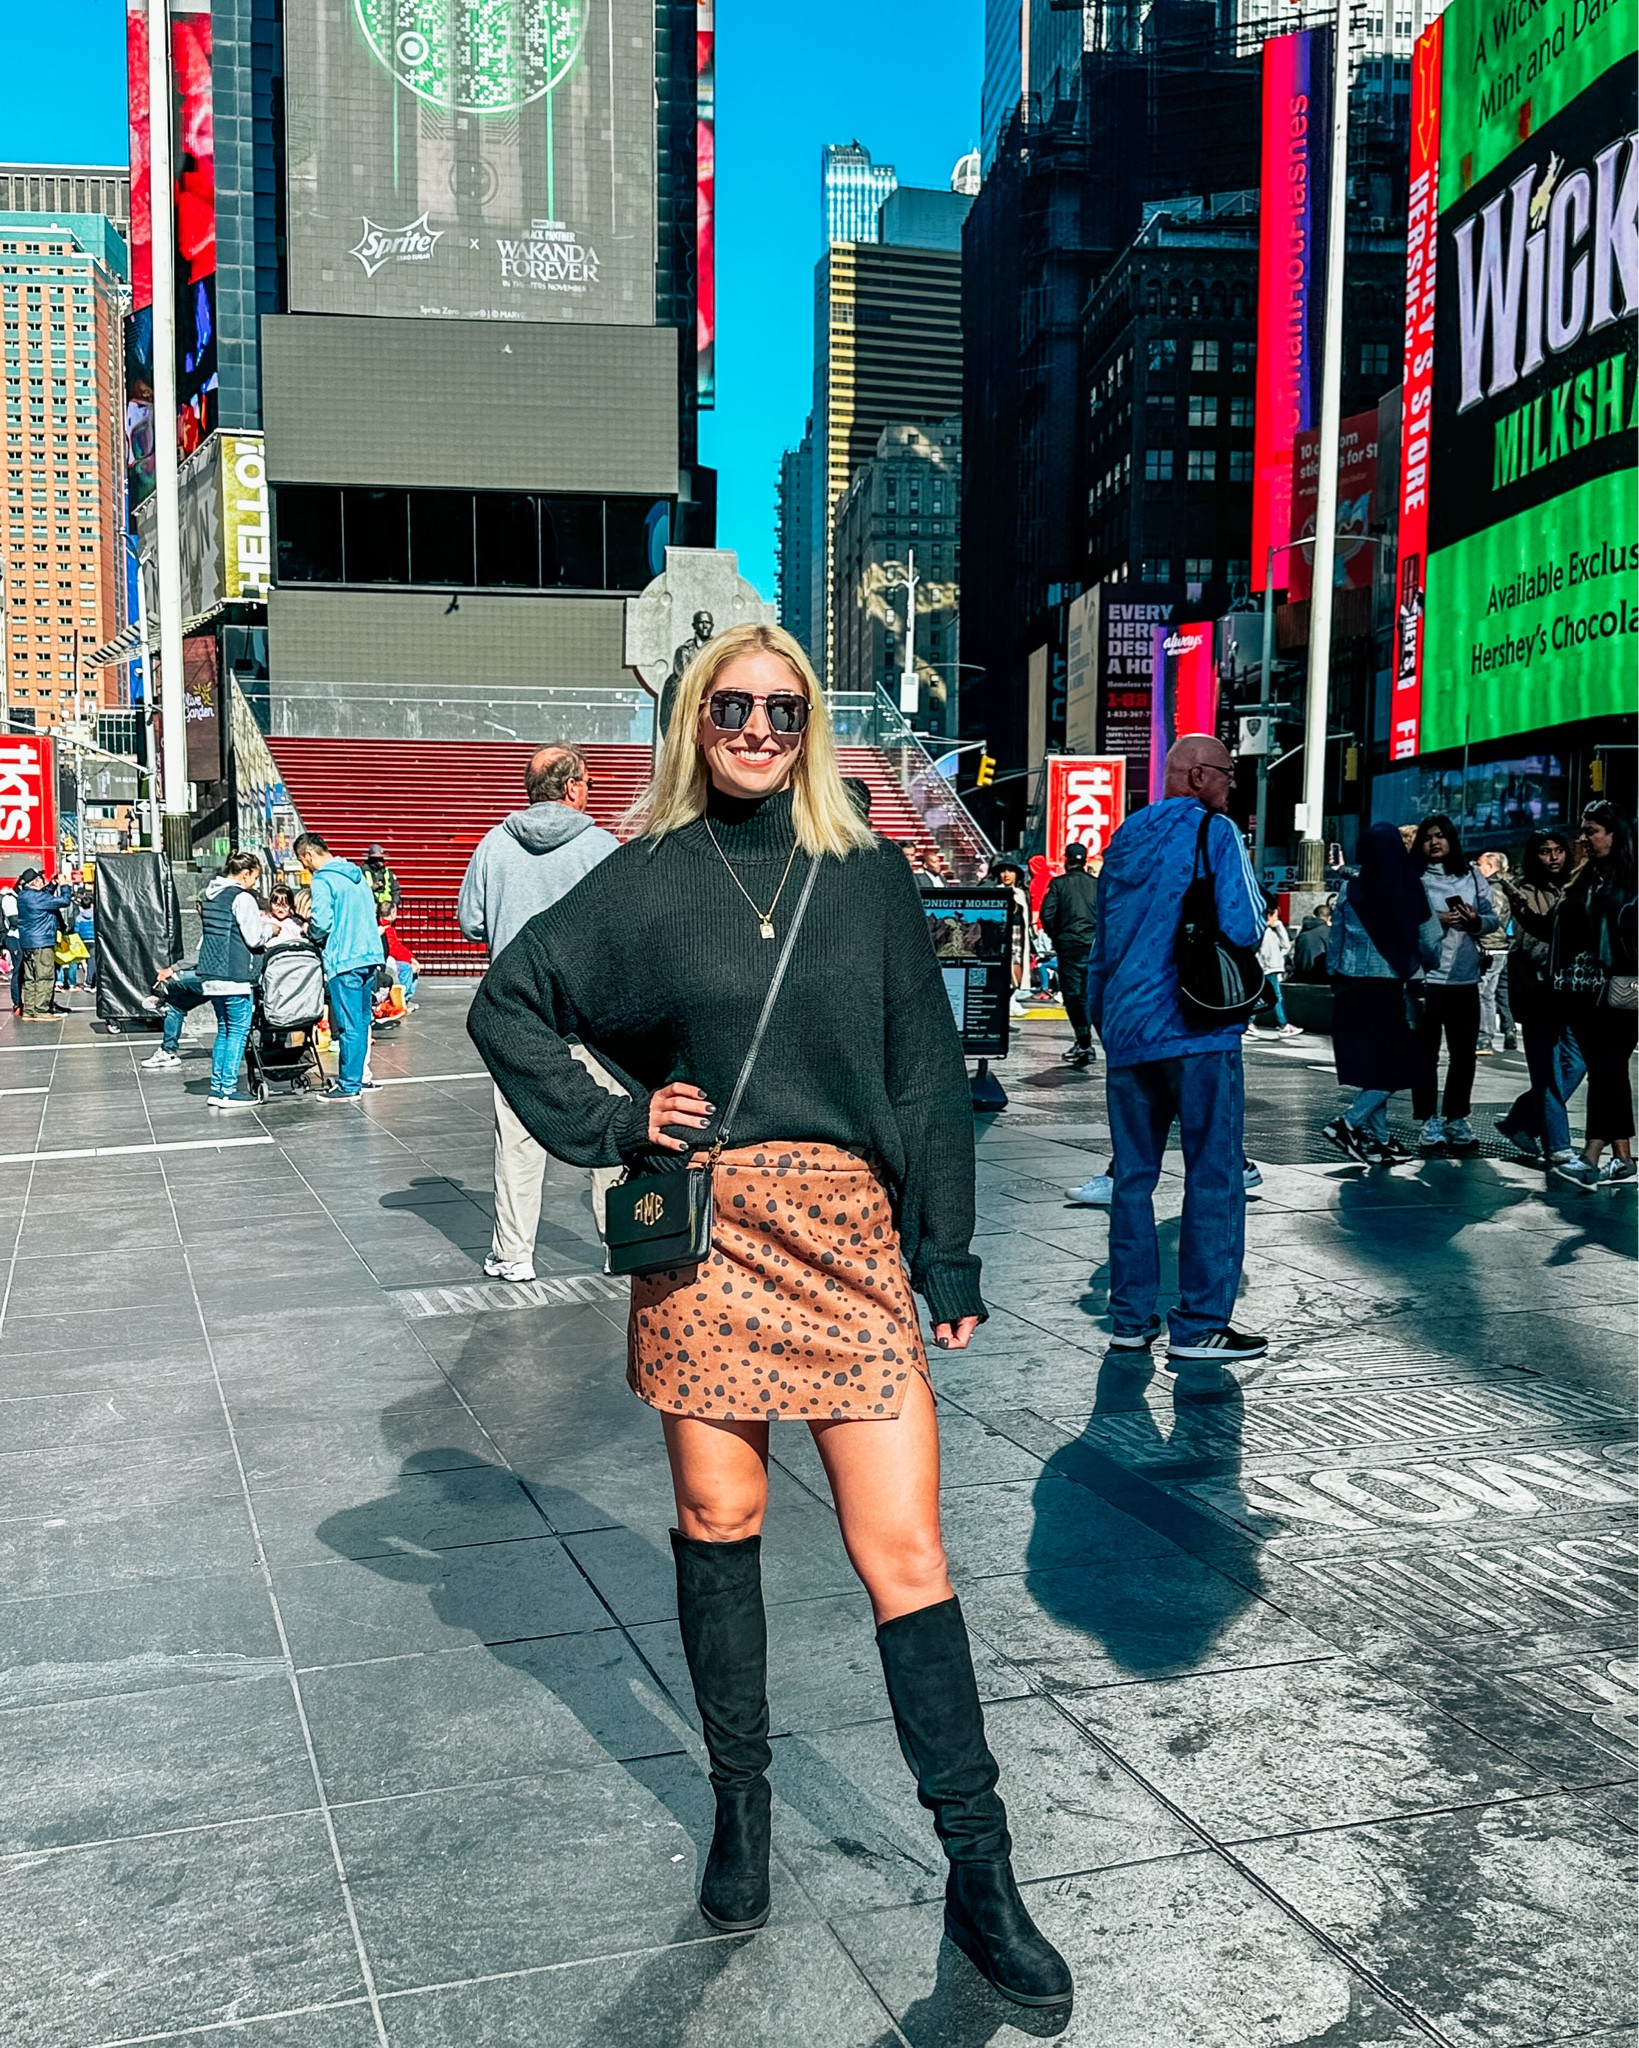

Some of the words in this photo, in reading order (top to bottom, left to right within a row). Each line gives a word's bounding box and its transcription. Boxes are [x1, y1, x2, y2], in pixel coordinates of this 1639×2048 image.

[1473, 32, 1487, 75] A
[1478, 63, 1521, 128] Mint
[1526, 12, 1565, 83] and
[361, 230, 432, 259] Sprite
[496, 239, 601, 265] WAKANDA
[501, 258, 600, 283] FOREVER
[1301, 443, 1312, 460] 10
[1347, 449, 1364, 466] for
[1404, 384, 1433, 516] STORE
[235, 438, 272, 595] HELLO!
[1486, 562, 1564, 616] Available
[1108, 604, 1173, 620] EVERY
[1163, 632, 1203, 651] always
[1471, 623, 1547, 676] Hershey's
[1106, 658, 1121, 674] A
[0, 743, 41, 841] tkts
[1262, 1381, 1371, 1397] STREET
[1414, 1434, 1536, 1454] STREET
